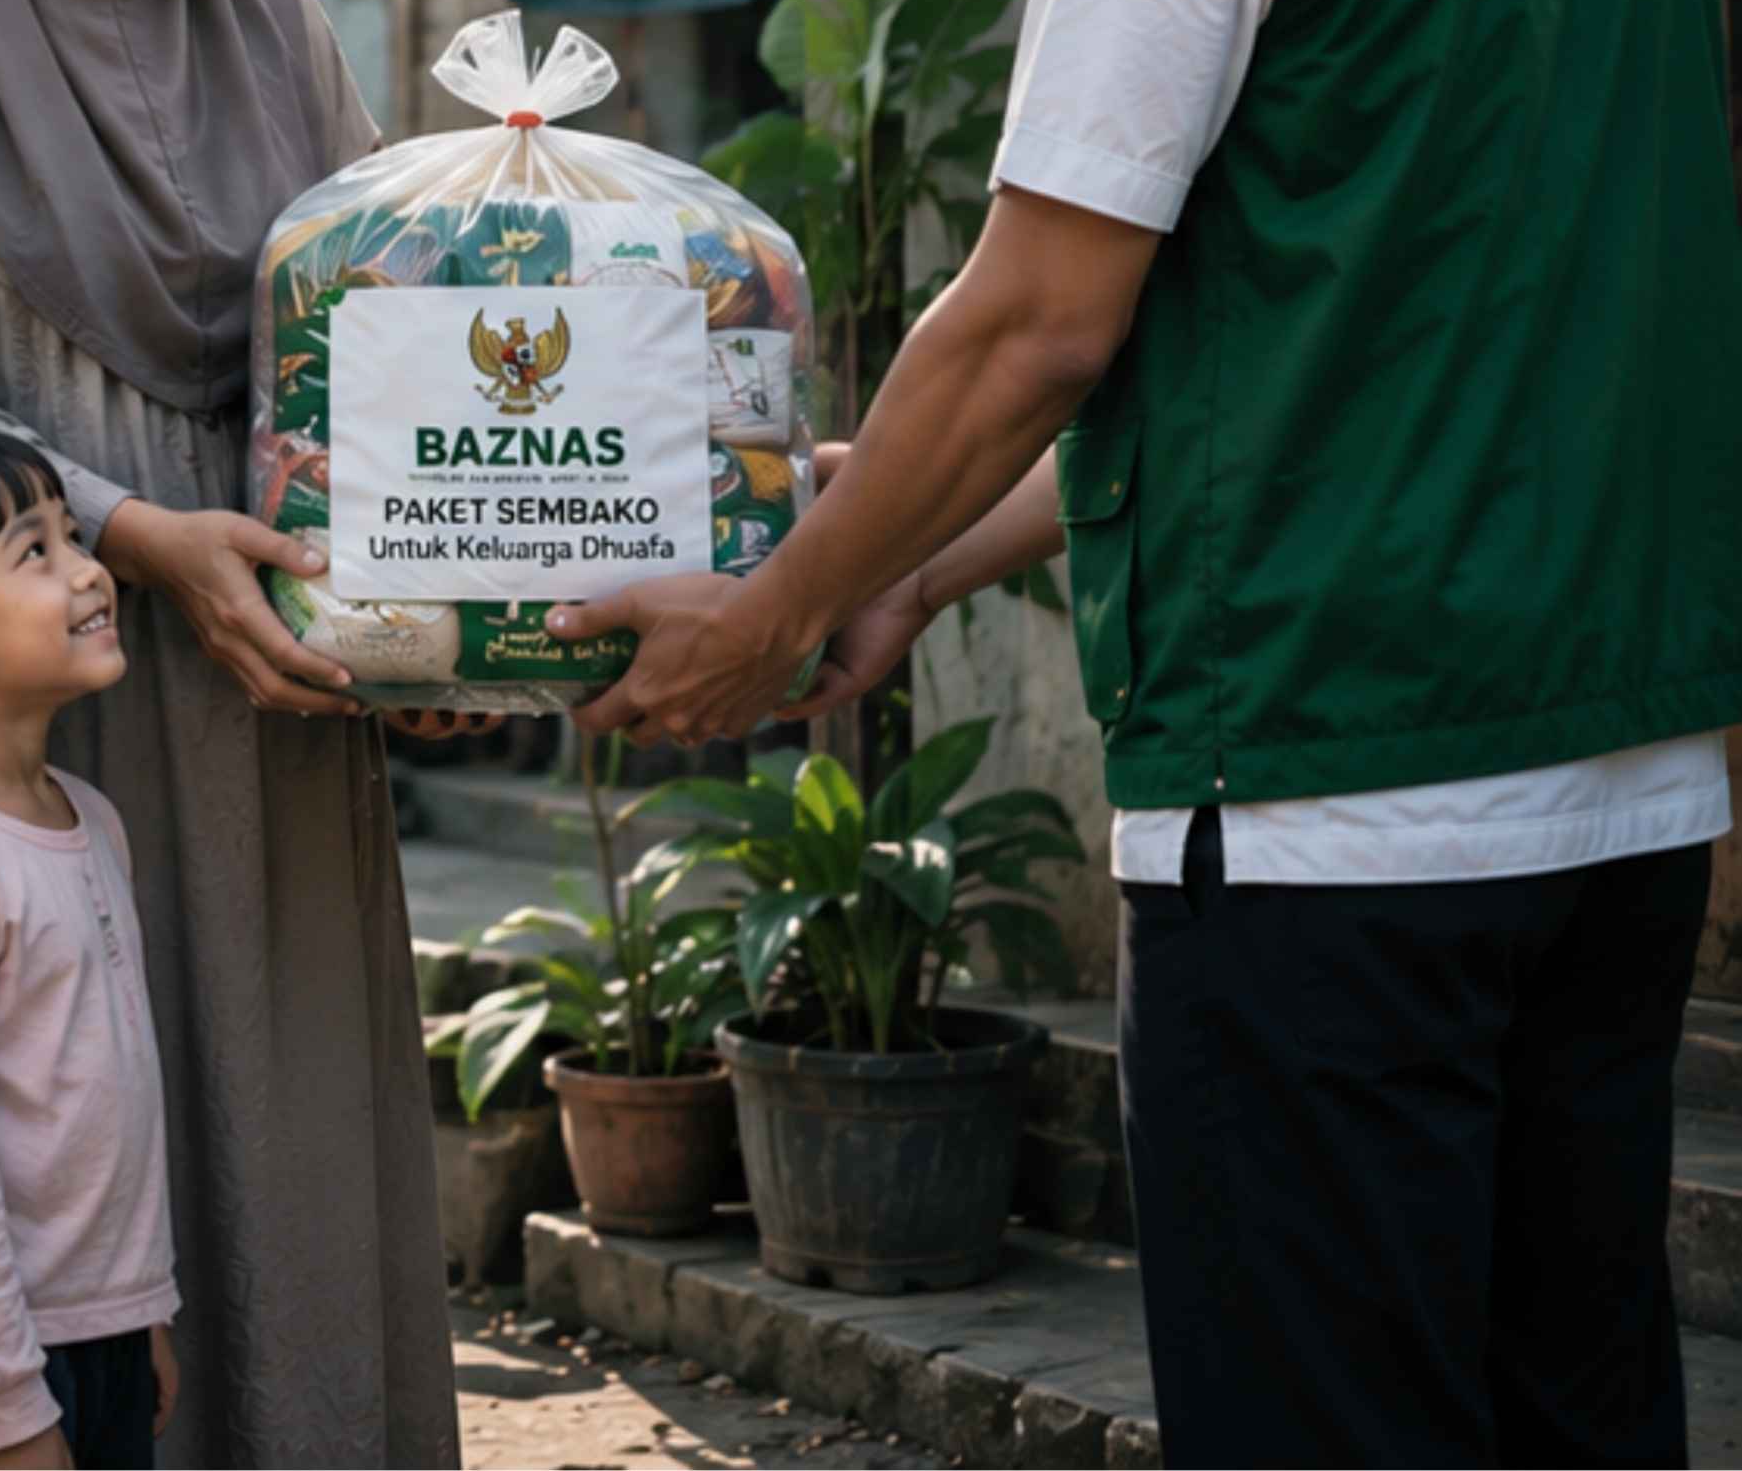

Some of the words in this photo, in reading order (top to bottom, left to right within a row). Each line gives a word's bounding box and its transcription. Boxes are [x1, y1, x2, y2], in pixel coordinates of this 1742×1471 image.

[415, 426, 625, 468] BAZNAS
[384, 497, 488, 525] PAKET
[496, 497, 660, 526] SEMBAKO
[368, 535, 449, 561] Untuk
[456, 535, 573, 569] Keluarga
[581, 533, 676, 561] Dhuafa
